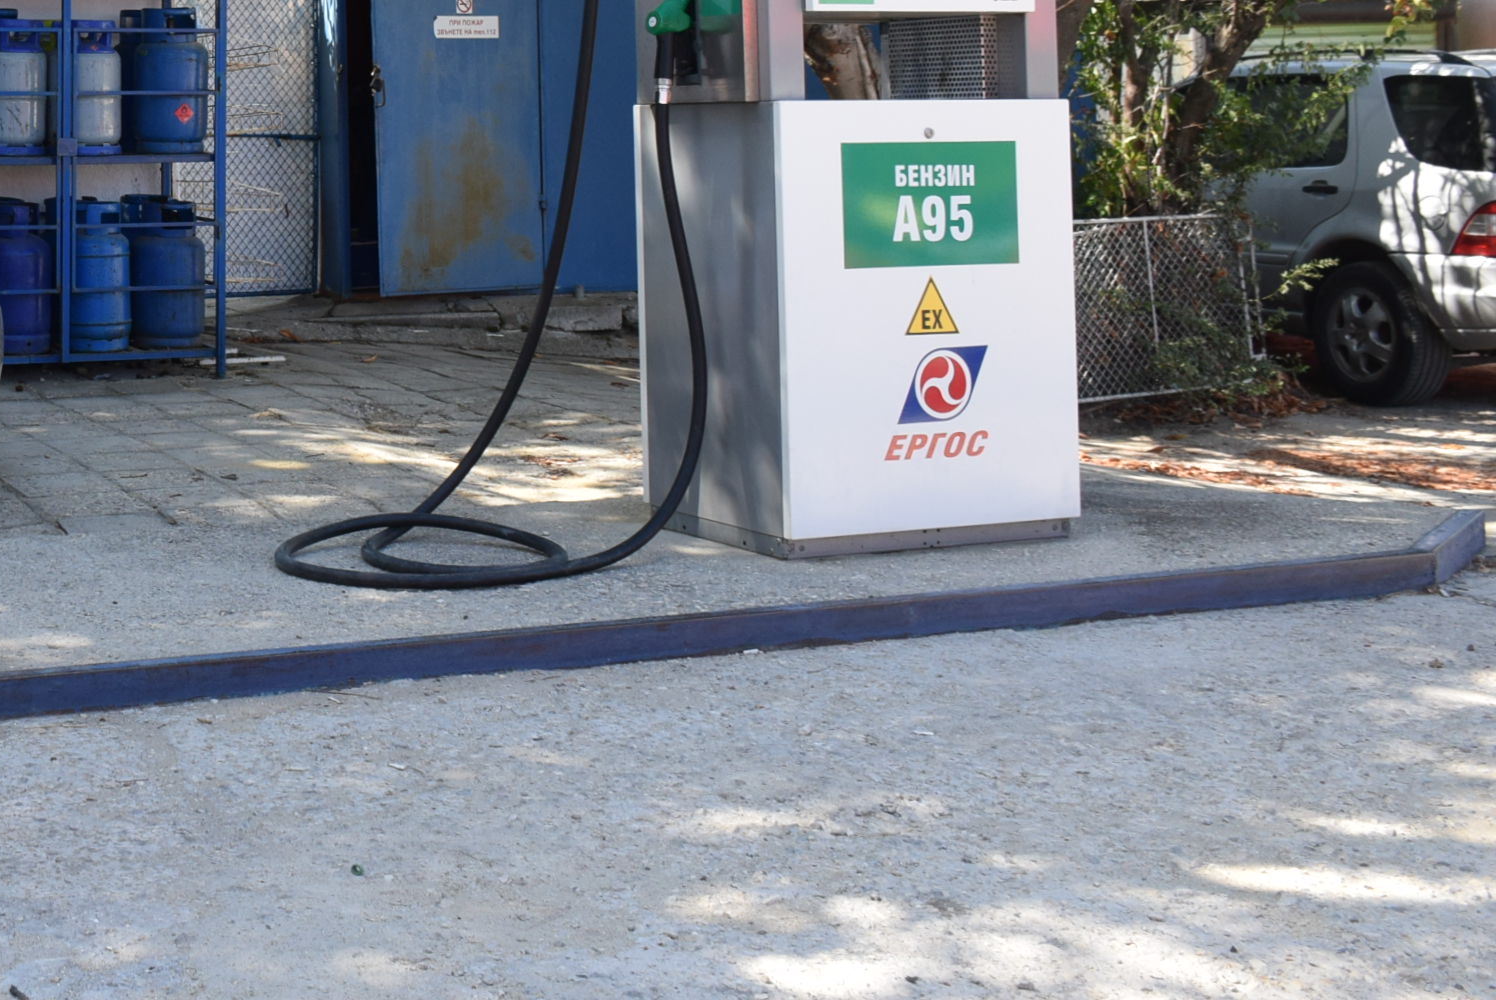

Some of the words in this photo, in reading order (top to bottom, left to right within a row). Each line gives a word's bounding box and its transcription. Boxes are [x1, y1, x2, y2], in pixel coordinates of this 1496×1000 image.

[894, 164, 975, 187] БЕНЗИН
[892, 194, 974, 243] А95
[921, 309, 943, 330] EX
[884, 430, 989, 461] ЕРГОС
